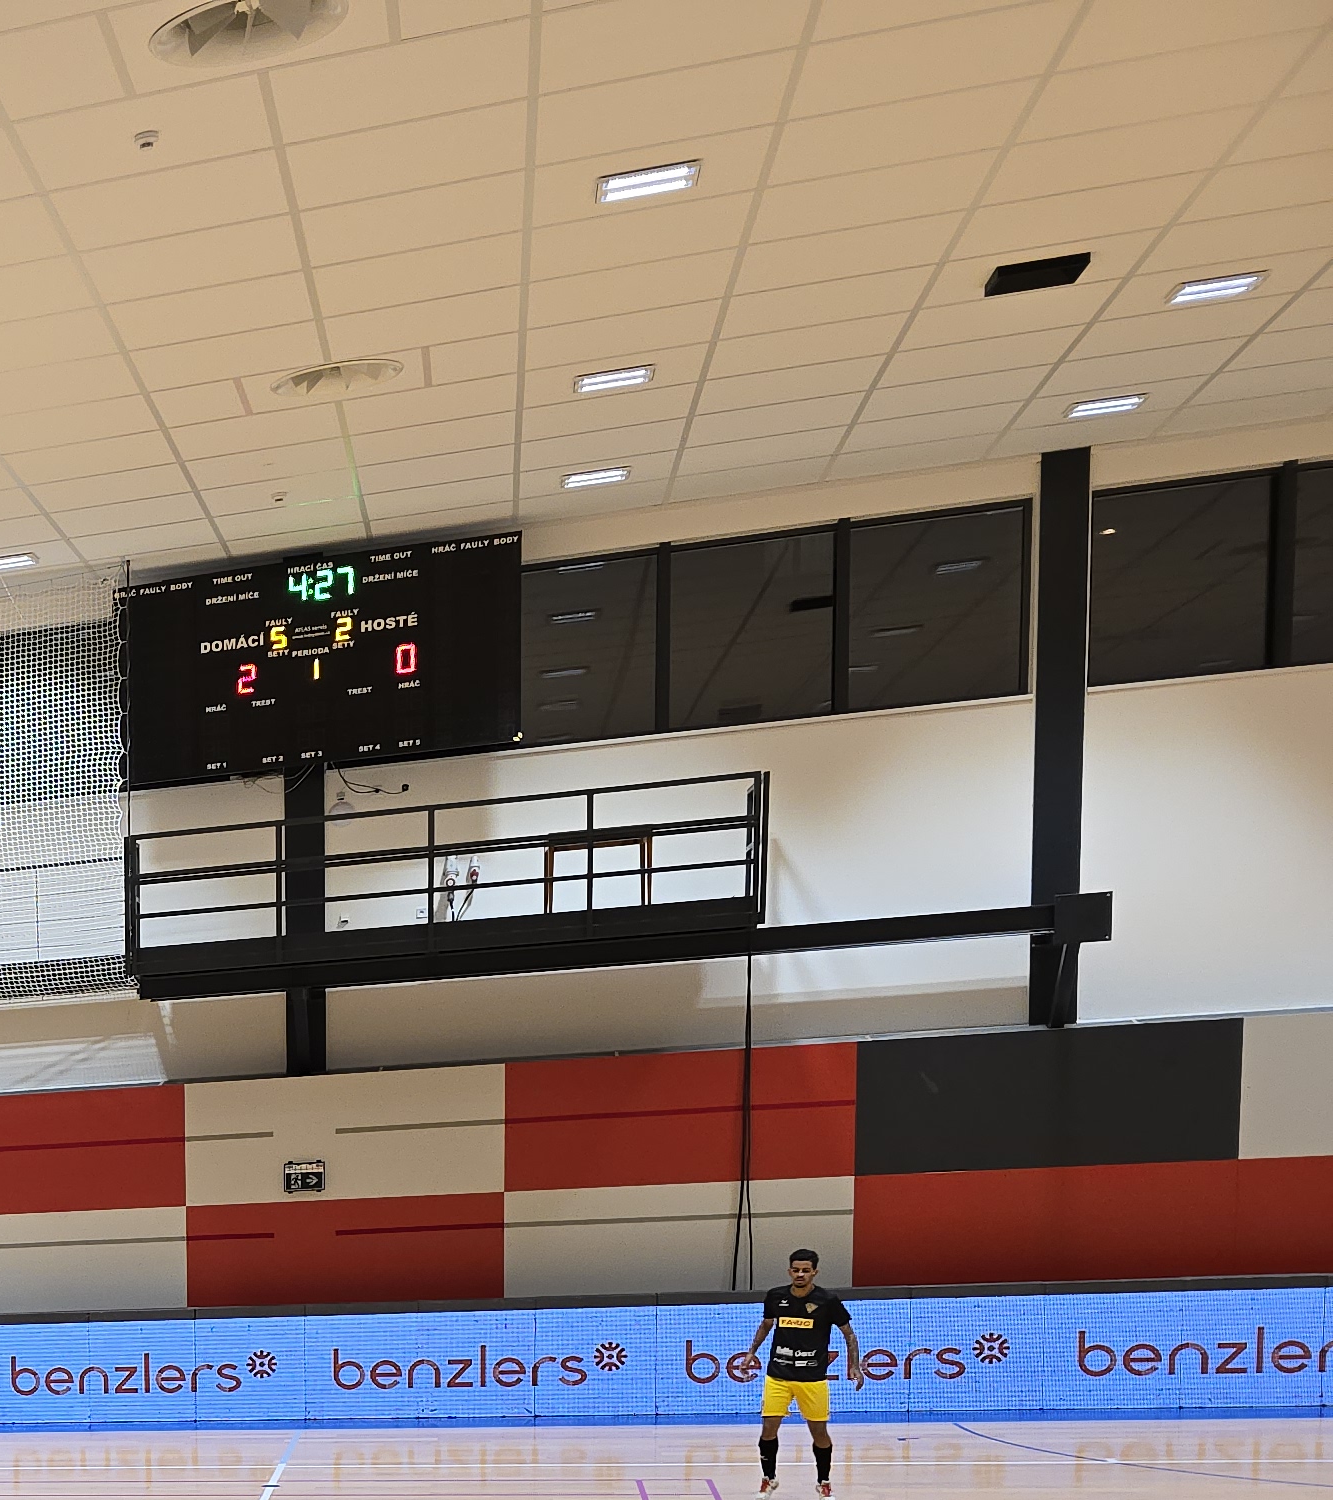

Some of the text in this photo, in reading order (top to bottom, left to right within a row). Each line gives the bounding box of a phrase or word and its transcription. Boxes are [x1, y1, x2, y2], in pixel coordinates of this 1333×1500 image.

[431, 535, 519, 555] HRÁČ FAULY BODY
[370, 550, 413, 563] TIME OUT
[287, 563, 314, 574] HRACÍ
[212, 573, 253, 585] TIME OUT
[287, 565, 355, 601] 4:27
[362, 569, 419, 584] DRŽENÍ MÍČE
[140, 585, 167, 597] FAULY
[170, 581, 193, 591] BODY
[205, 591, 260, 606] DRŽENÍ MÍČE
[330, 608, 359, 619] FAULY
[265, 617, 293, 627] FAULY
[335, 616, 353, 642] 2
[360, 612, 419, 633] HOSTÉ
[200, 632, 265, 654] DOMÁCÍ
[270, 626, 288, 650] 5
[291, 647, 330, 658] PERIODA
[394, 642, 417, 676] 0
[236, 663, 258, 696] 2
[347, 686, 373, 696] TREST
[251, 699, 276, 708] TREST
[398, 740, 414, 748] SET
[262, 756, 277, 764] SET
[301, 751, 316, 759] SET
[206, 762, 221, 770] SET
[10, 1352, 242, 1397] benzlers
[332, 1344, 588, 1391] benzlers
